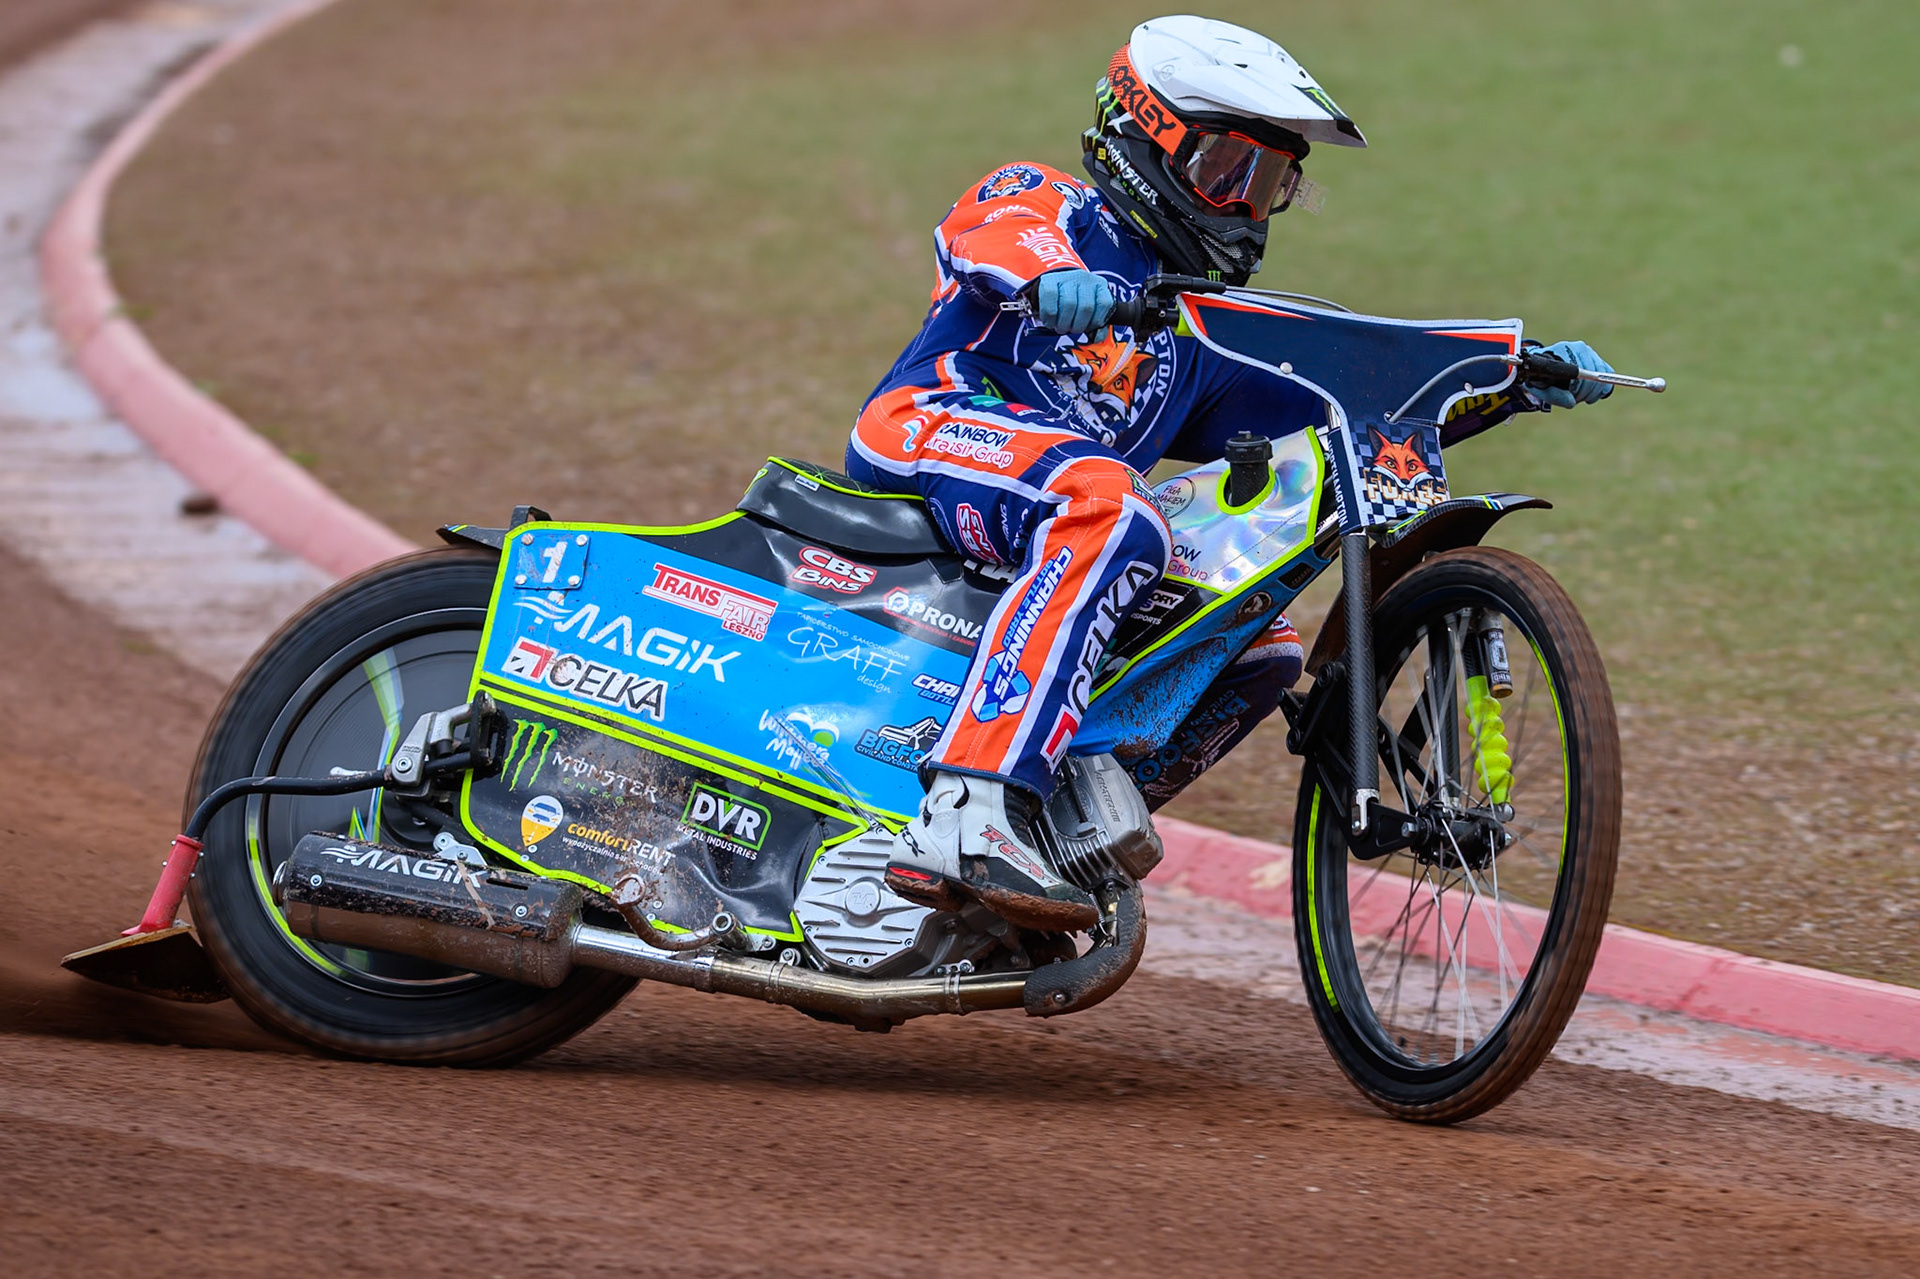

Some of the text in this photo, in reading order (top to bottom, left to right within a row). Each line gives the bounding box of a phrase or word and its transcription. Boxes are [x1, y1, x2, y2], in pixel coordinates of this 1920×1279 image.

[1112, 65, 1177, 137] OAKLEY
[1105, 137, 1159, 206] MONSTER
[974, 447, 1013, 466] Group
[542, 541, 568, 583] 1
[792, 567, 862, 592] BINS
[802, 548, 875, 584] CBS
[1168, 561, 1208, 581] Group
[654, 563, 722, 607] TRANS
[719, 598, 771, 633] FAIR
[722, 619, 765, 641] LESZNO
[787, 626, 907, 681] GRAFF
[550, 657, 664, 717] CELKA
[856, 672, 893, 694] design
[552, 752, 659, 804] MONSTER
[692, 792, 761, 841] DVR
[676, 824, 758, 861] METAL INDUSTRIES
